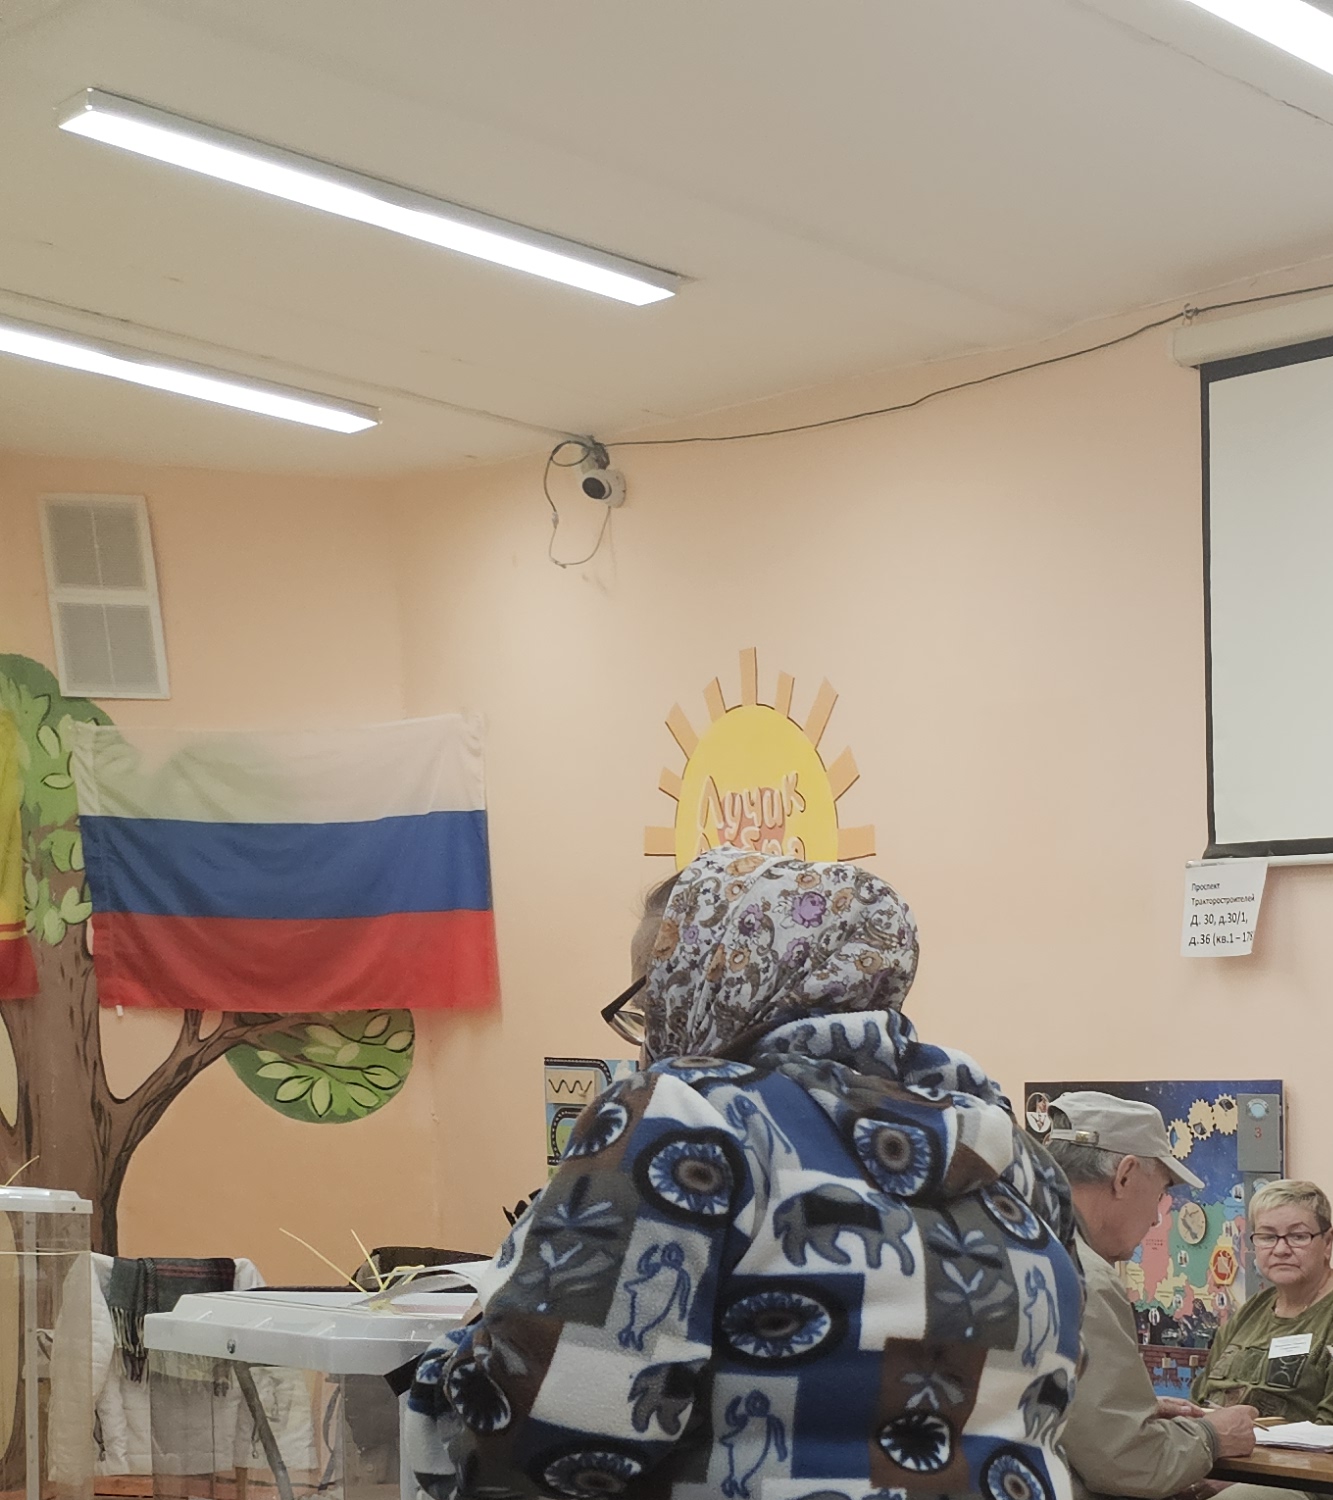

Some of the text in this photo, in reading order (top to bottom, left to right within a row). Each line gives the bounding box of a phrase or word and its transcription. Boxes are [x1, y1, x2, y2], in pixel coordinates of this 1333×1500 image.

[696, 772, 806, 841] Лучик
[1191, 883, 1220, 892] Проспект
[1191, 894, 1255, 906] Тракторостроителей
[1190, 911, 1248, 927] Д. 30, д.30/1,
[1188, 934, 1211, 946] д.36
[1212, 933, 1234, 946] (кв.1
[1254, 1126, 1262, 1140] 3
